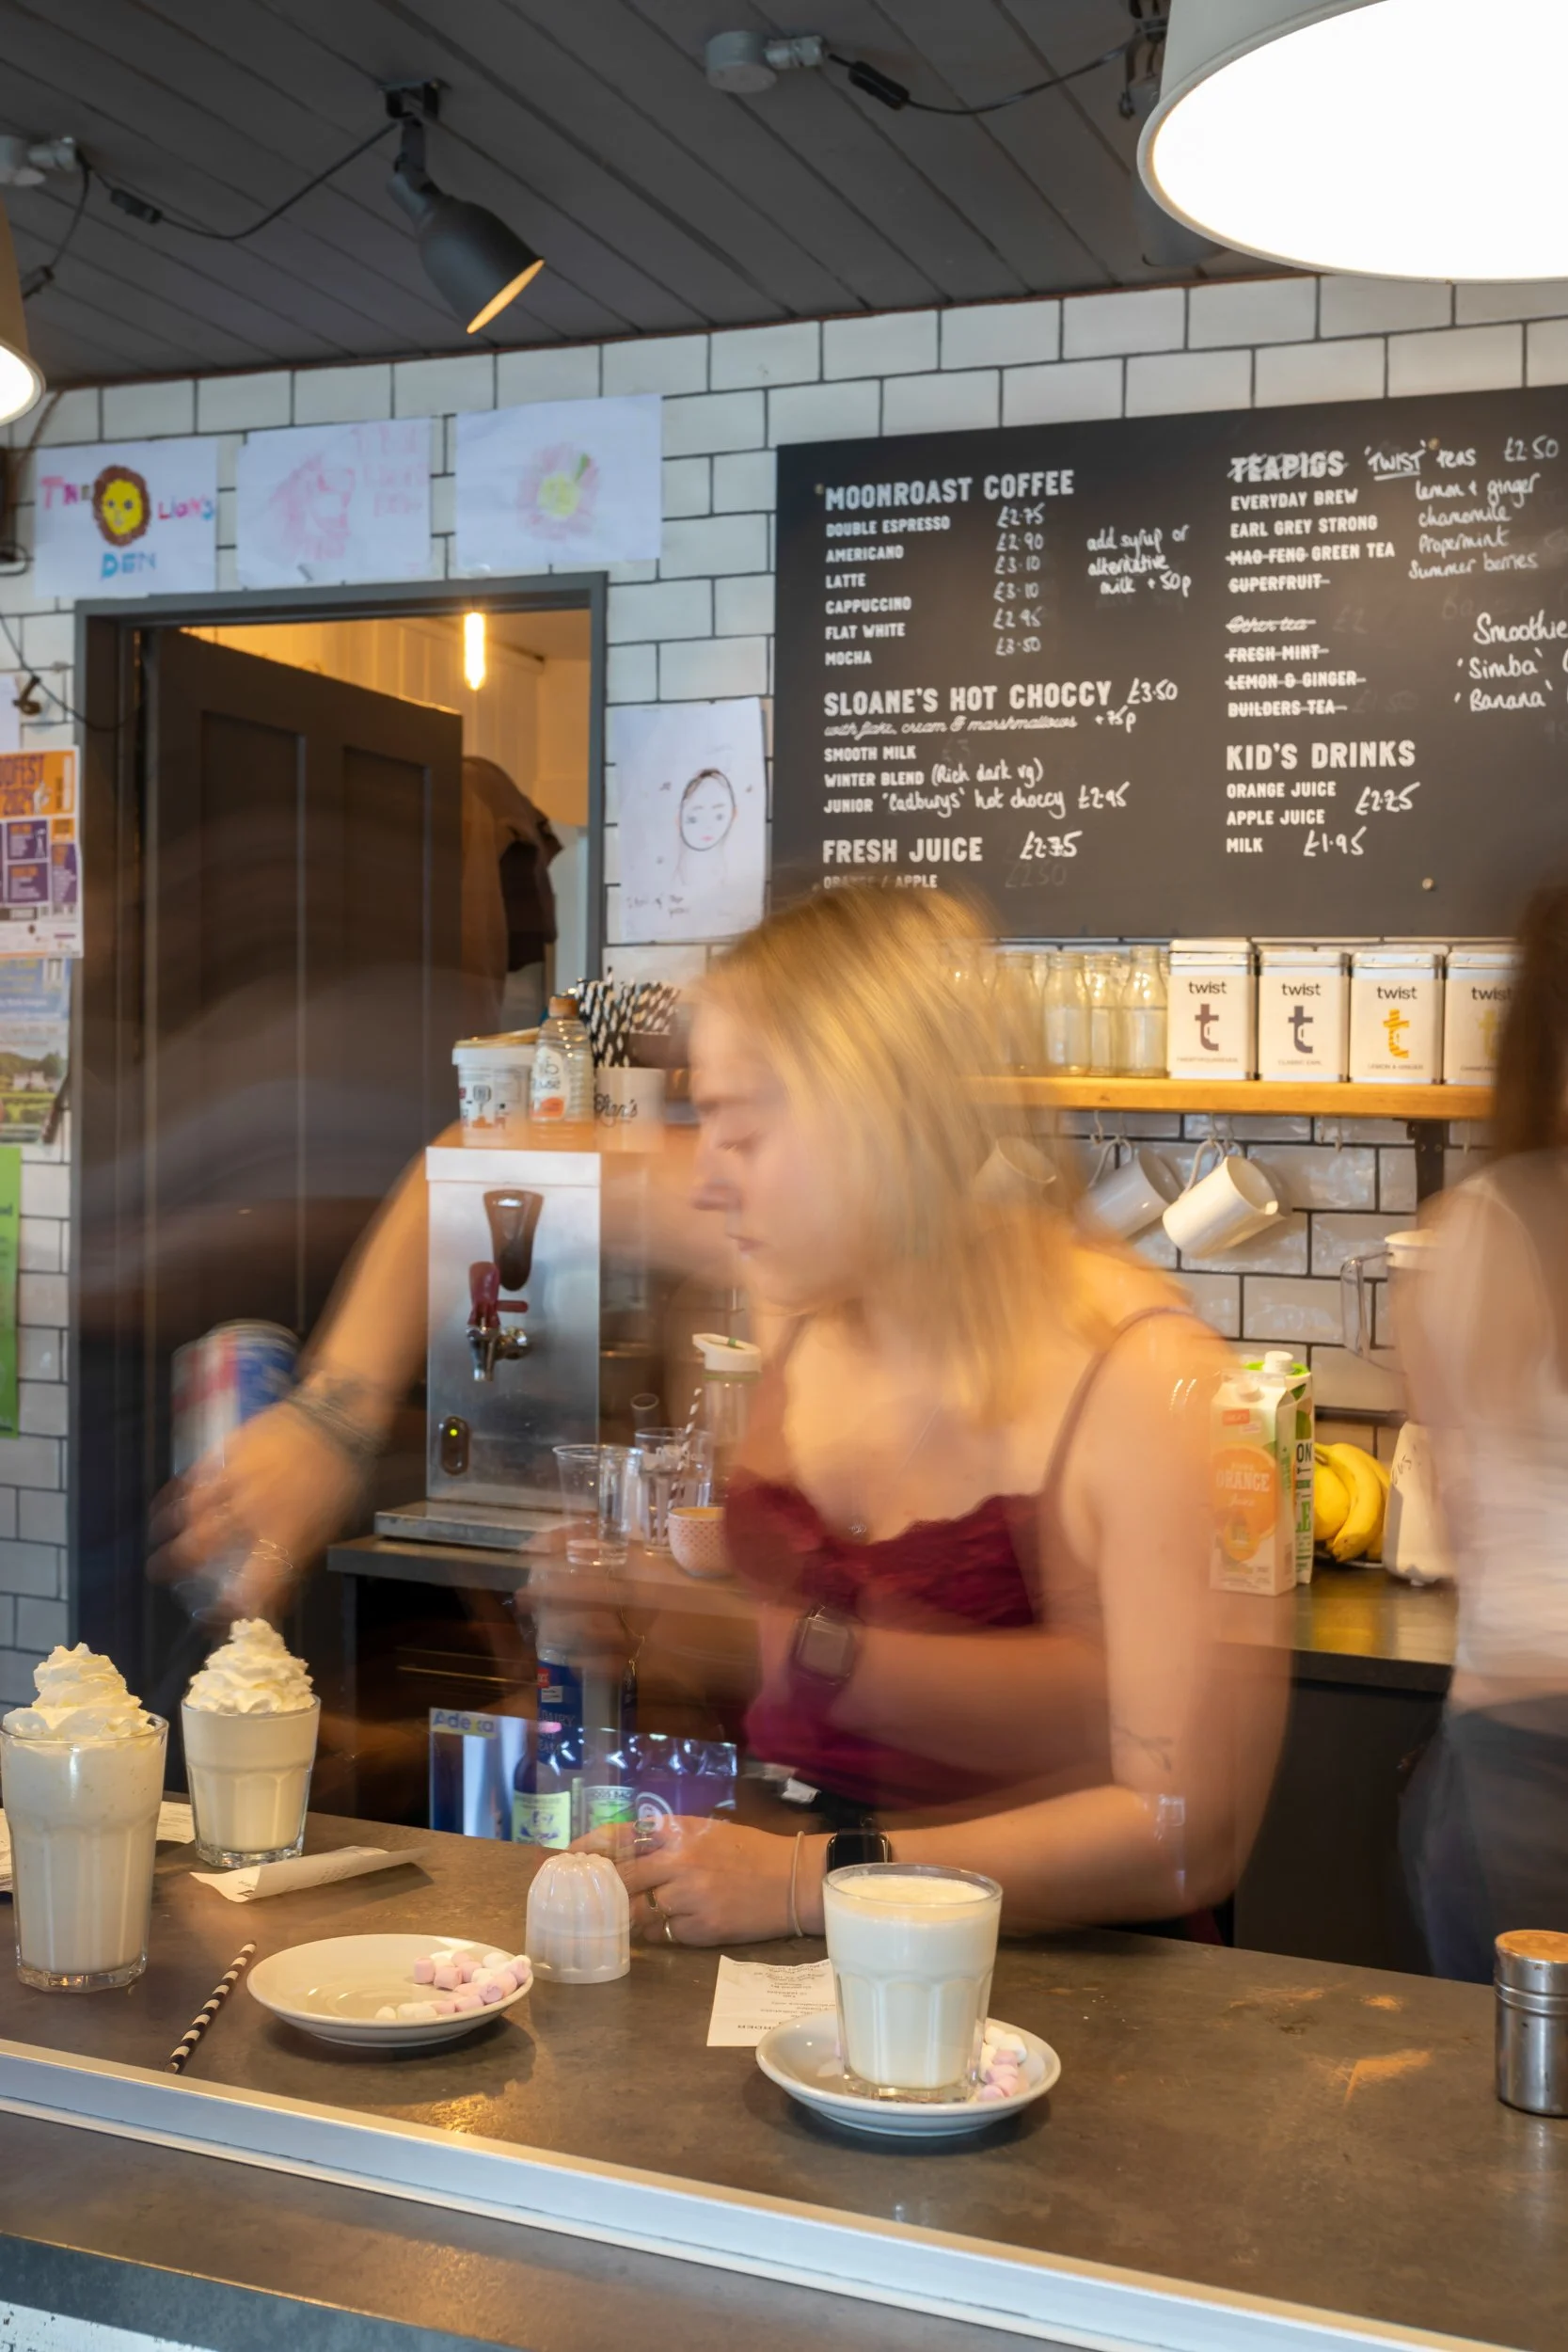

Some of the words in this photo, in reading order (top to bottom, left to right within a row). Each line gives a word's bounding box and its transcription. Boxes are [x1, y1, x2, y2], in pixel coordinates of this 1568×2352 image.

[825, 478, 973, 511] MOONROAST
[983, 470, 1075, 501] COFFEE
[1230, 492, 1308, 512] EVERYDAY
[1313, 487, 1359, 506] BREW
[1487, 472, 1541, 508] ginger
[826, 520, 877, 537] DOUBLE
[882, 516, 951, 534] ESPRESSO
[1229, 521, 1269, 539] EARL
[1274, 518, 1313, 536] GREY
[1318, 514, 1379, 534] STRONG
[1086, 526, 1117, 551] add
[825, 545, 905, 563] AMERICANO
[1227, 548, 1263, 565] MAO
[1269, 546, 1308, 564] FENG
[1311, 543, 1361, 562] GREEN
[1366, 541, 1396, 558] TEA
[825, 572, 866, 590] LATTE
[1228, 572, 1326, 594] SUPERFRUIT
[825, 596, 912, 614] CAPPUCCINO
[824, 625, 858, 641] FLAT
[863, 622, 907, 639] WHITE
[824, 649, 873, 666] MOCHA
[1227, 645, 1276, 663] FRESH
[1281, 644, 1321, 661] MINT
[1227, 673, 1278, 691] LEMON
[1302, 669, 1358, 689] GINGER
[824, 687, 939, 717] SLOANE'S
[949, 685, 998, 712] HOT
[1009, 680, 1112, 709] CHOCCY
[1227, 699, 1301, 718] BUILDERS
[1307, 698, 1337, 716] TEA
[824, 746, 879, 763] SMOOTH
[882, 745, 917, 760] MILK
[1226, 742, 1298, 771] KID'S
[1311, 739, 1417, 770] DRINKS
[824, 772, 877, 788] WINTER
[880, 771, 926, 787] BLEND
[975, 758, 1013, 783] dark
[974, 787, 1005, 810] hot
[1226, 782, 1286, 799] ORANGE
[1291, 781, 1337, 797] JUICE
[823, 798, 875, 814] JUNIOR
[1226, 811, 1275, 826] APPLE
[1279, 809, 1325, 825] JUICE
[822, 839, 897, 864] FRESH
[909, 836, 983, 863] JUICE
[1226, 837, 1263, 853] MILK
[895, 874, 938, 889] APPLE
[1188, 980, 1227, 994] twist
[1281, 983, 1322, 996] twist
[1376, 986, 1418, 1000] twist
